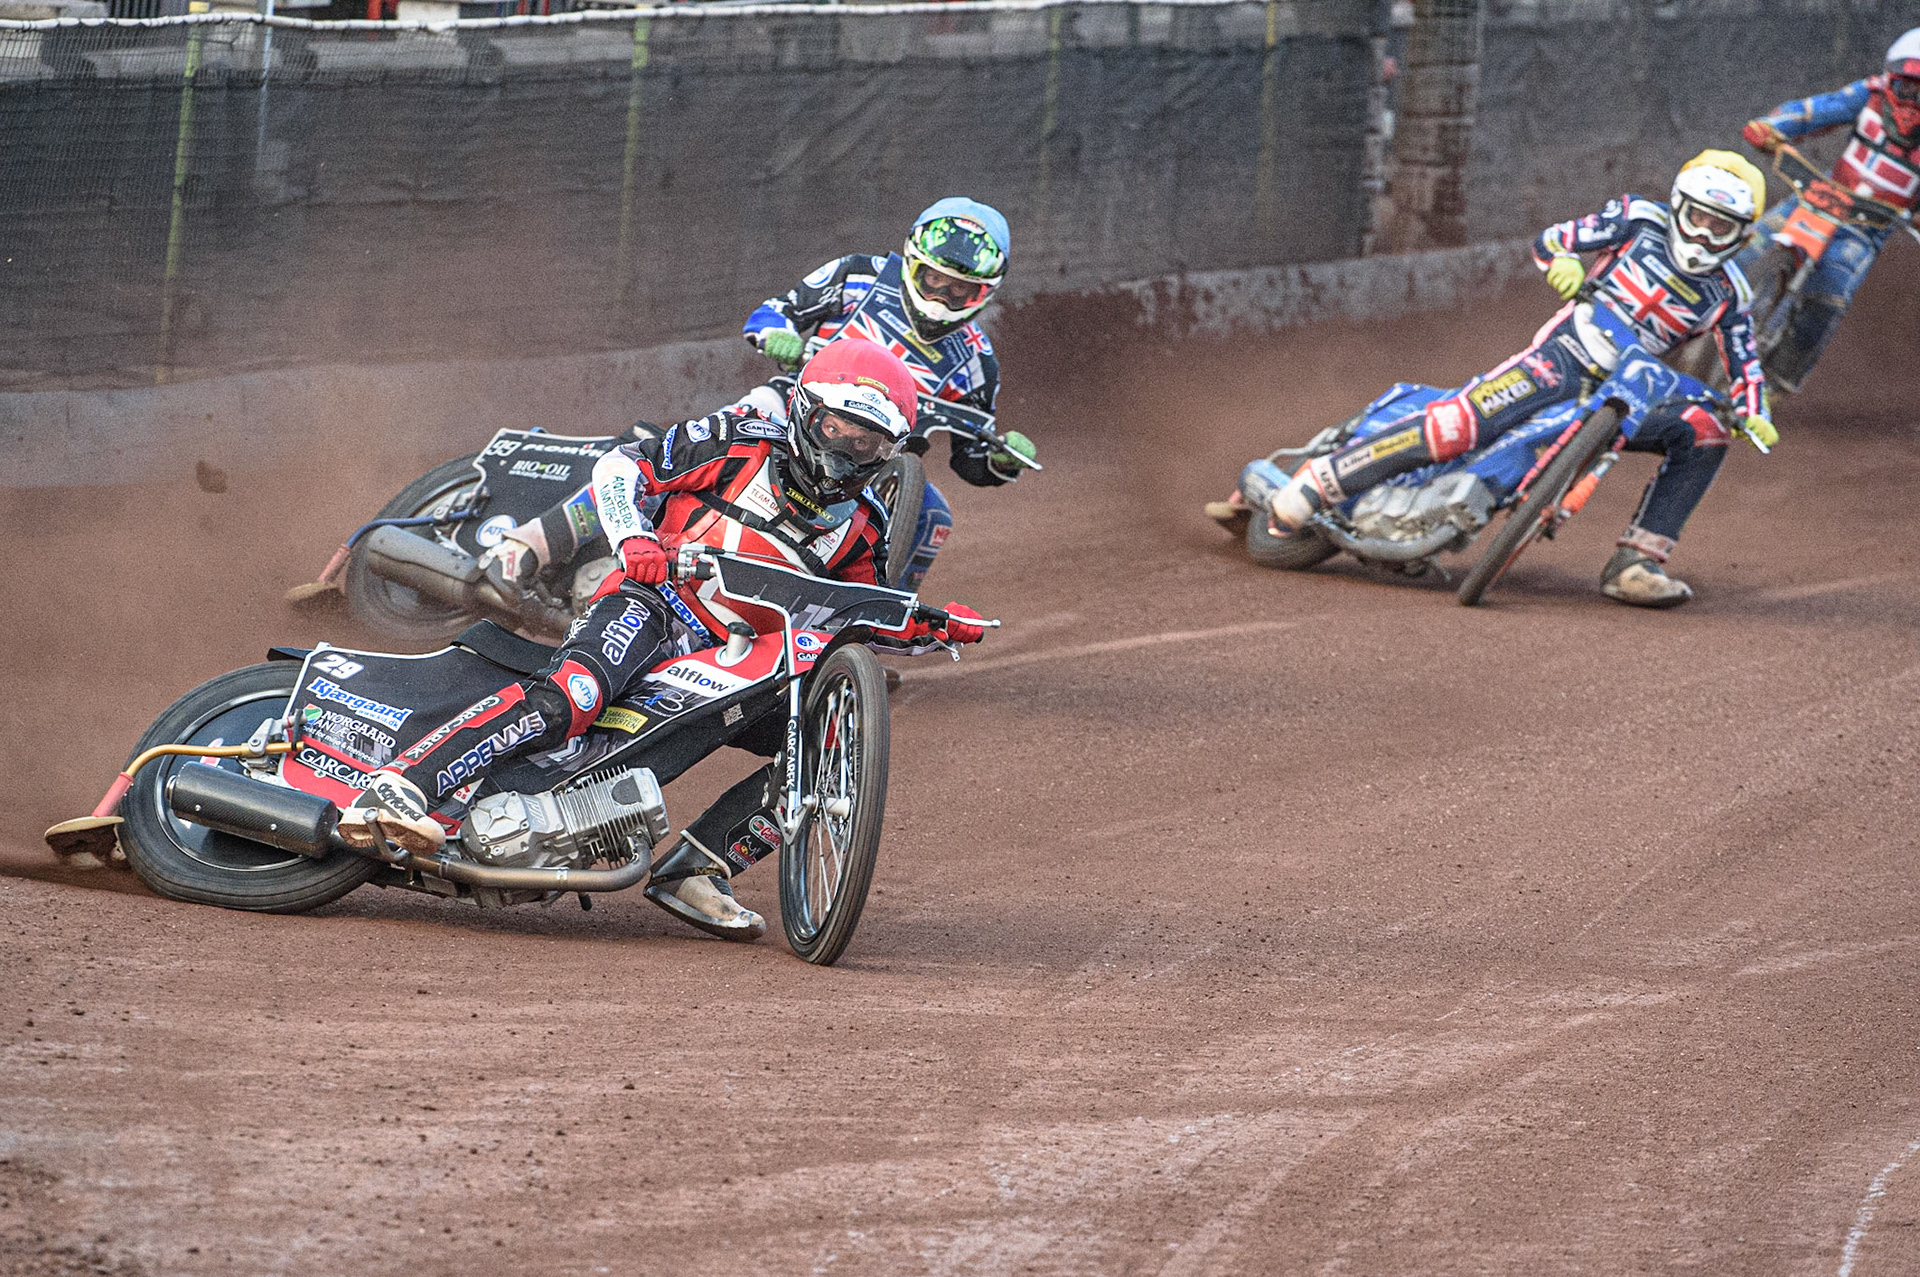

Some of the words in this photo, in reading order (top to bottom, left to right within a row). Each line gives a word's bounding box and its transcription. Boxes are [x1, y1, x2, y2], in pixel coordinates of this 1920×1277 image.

[750, 488, 771, 506] TEAM
[601, 597, 651, 666] alflow
[312, 654, 365, 680] 29
[797, 652, 819, 661] GAR
[667, 665, 729, 692] alflow
[309, 677, 410, 722] Kjærgaard
[313, 718, 358, 742] ANLÆG
[404, 694, 502, 760] GARCAREK
[300, 747, 376, 790] GARCAR
[787, 719, 797, 789] GARCAREK
